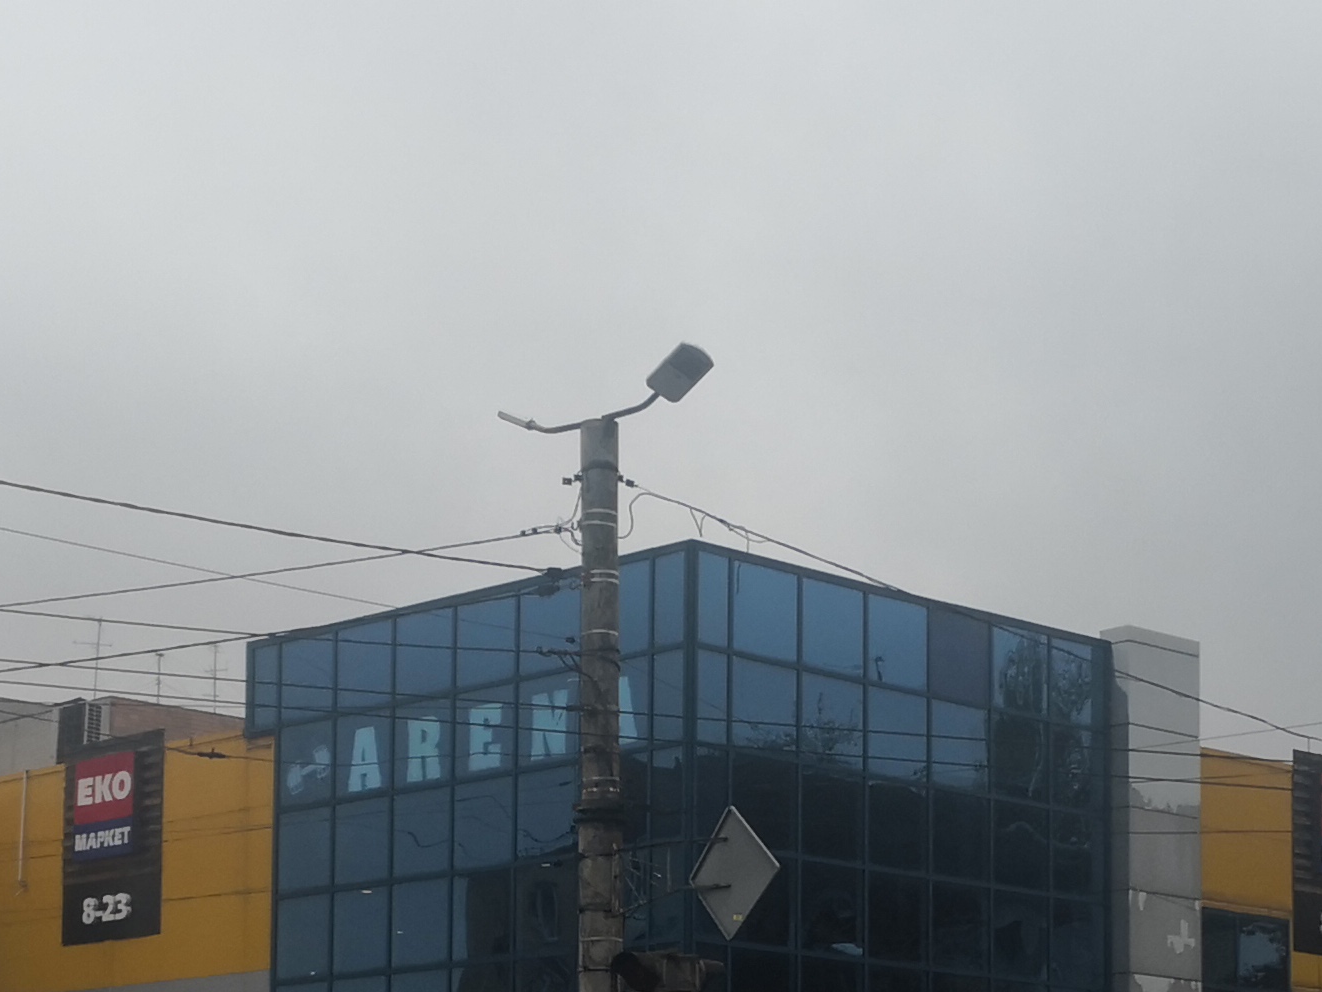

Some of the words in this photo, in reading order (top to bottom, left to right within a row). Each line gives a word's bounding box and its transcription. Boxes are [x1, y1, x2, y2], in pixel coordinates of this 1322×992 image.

[77, 770, 132, 807] ЕКО
[74, 826, 132, 852] МАРКЕТ
[81, 892, 132, 925] 8-23
